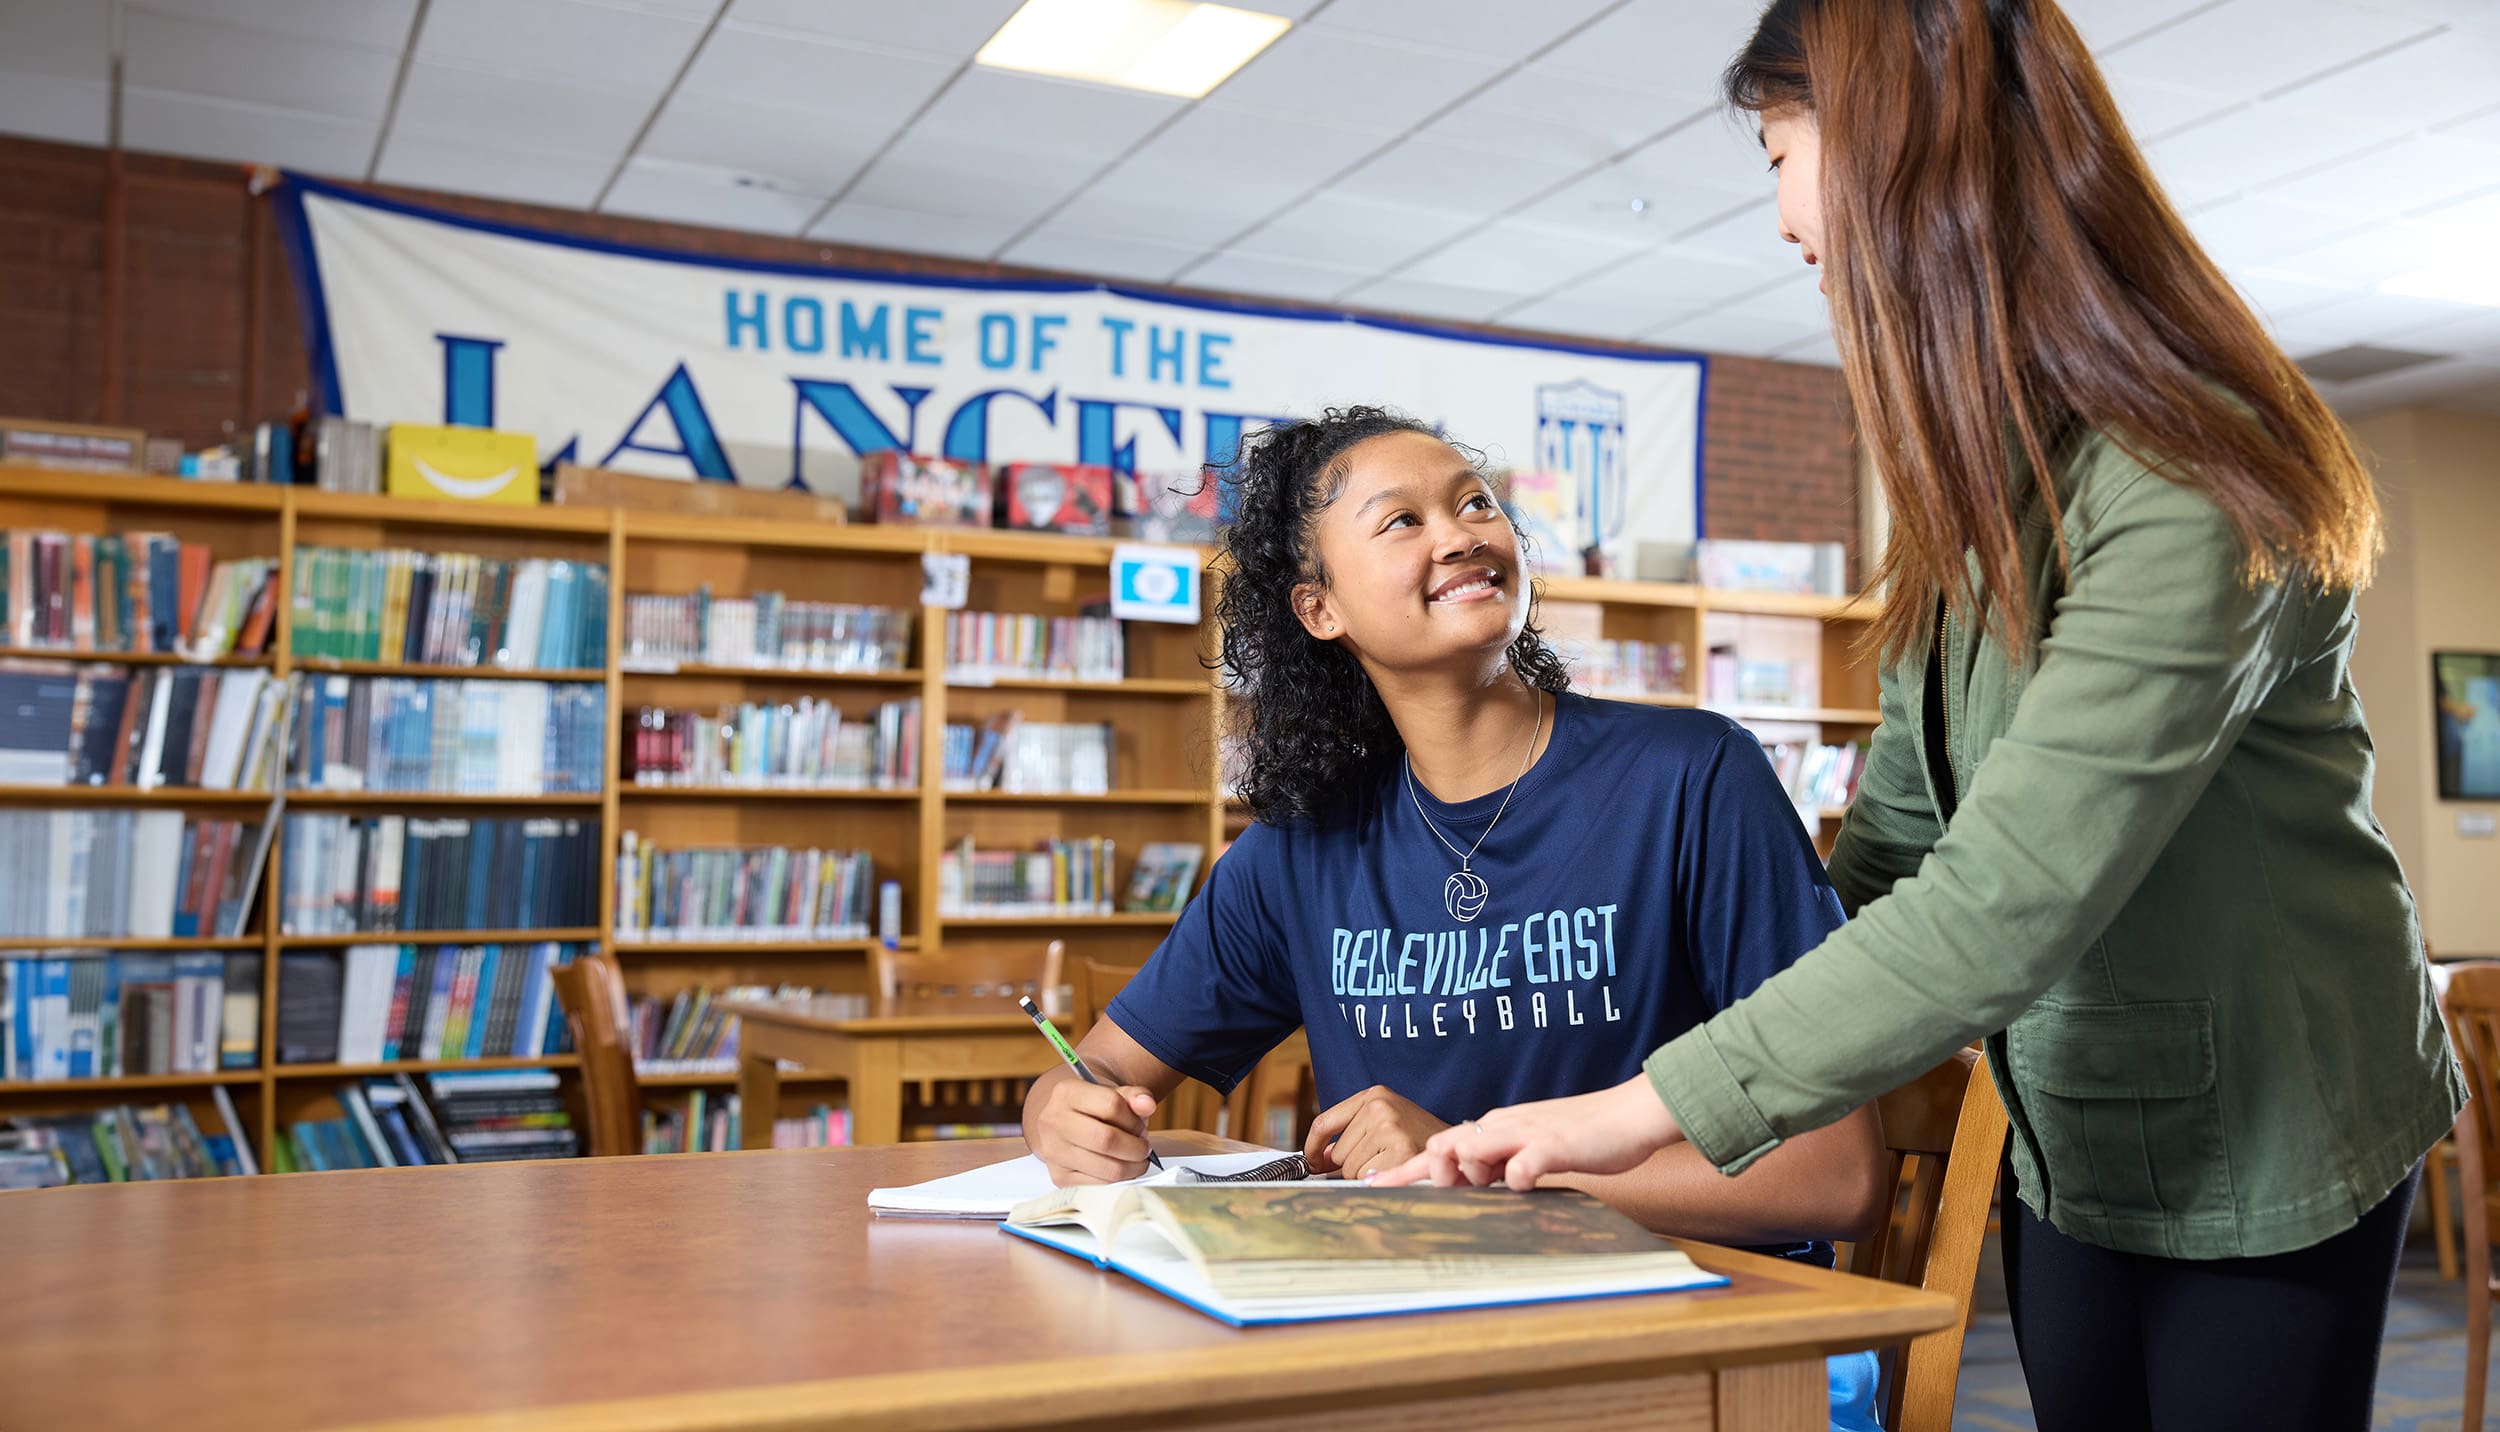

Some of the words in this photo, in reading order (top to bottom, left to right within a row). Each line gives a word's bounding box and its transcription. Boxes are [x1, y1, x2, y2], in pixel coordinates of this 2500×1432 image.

[724, 290, 943, 366] HOME
[979, 311, 1068, 373] OF
[1101, 315, 1234, 390] THE
[1331, 923, 1519, 997] BELLEVILLE
[1523, 904, 1618, 985] EAST
